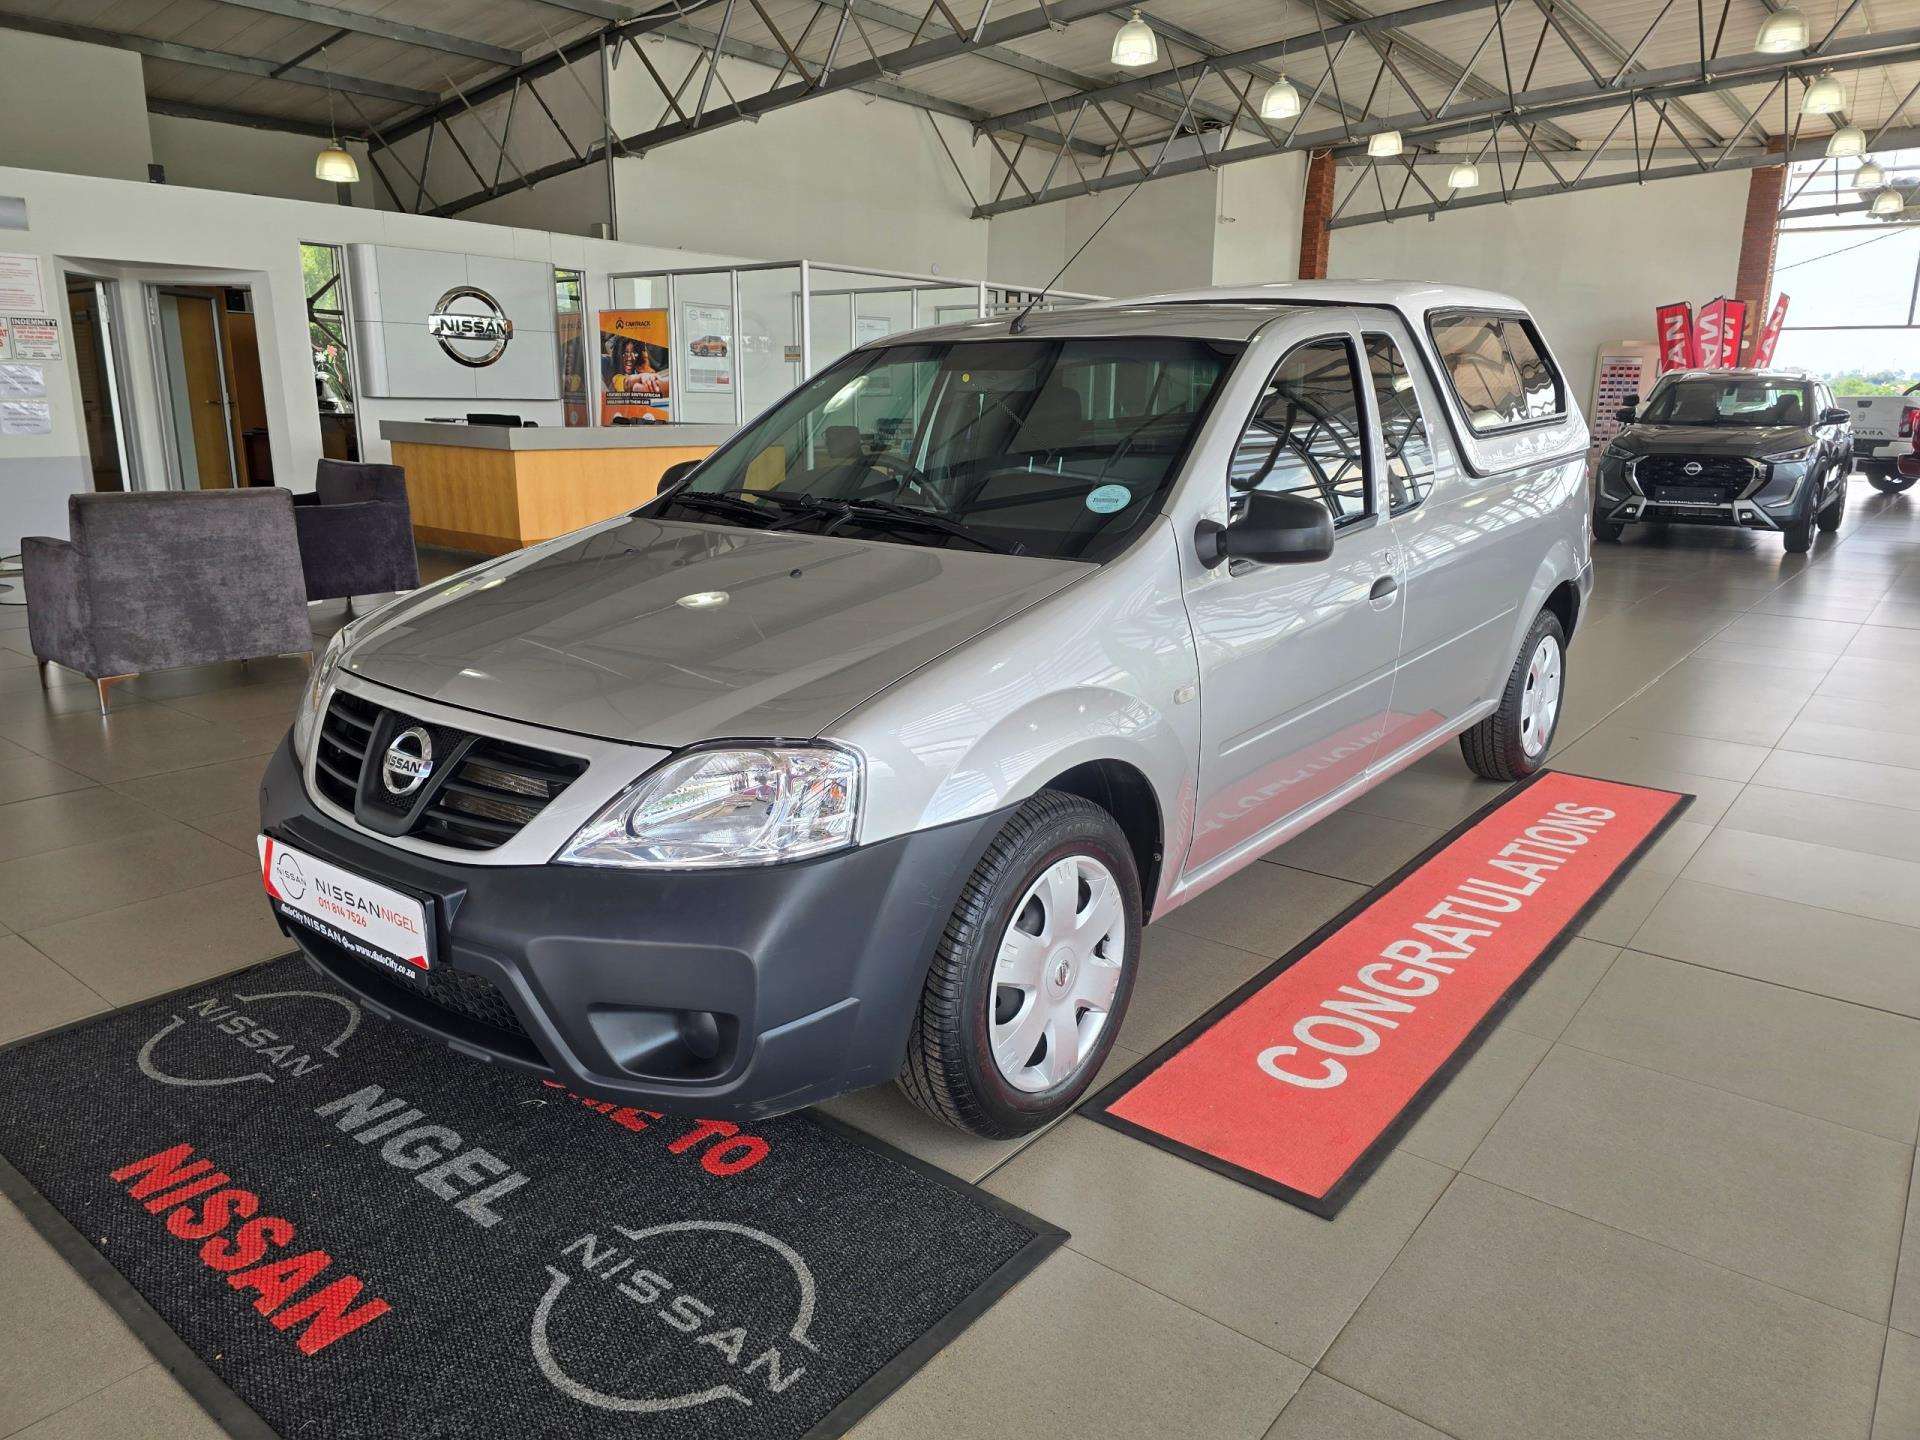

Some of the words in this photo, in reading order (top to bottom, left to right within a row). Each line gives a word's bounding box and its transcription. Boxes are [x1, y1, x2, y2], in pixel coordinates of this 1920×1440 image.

[11, 318, 57, 326] INDEMNITY
[440, 319, 506, 335] NISSAN
[386, 752, 421, 774] NISSAN
[276, 866, 307, 887] NISSAN
[303, 914, 342, 944] NISSAN
[318, 896, 331, 911] 011
[332, 903, 346, 918] 814
[346, 908, 367, 928] 7526
[1256, 802, 1616, 1090] CONGRATULATIONS
[187, 998, 324, 1077] NISSAN
[314, 1083, 531, 1228] NIGEL
[668, 1118, 771, 1177] TO
[109, 1142, 393, 1357] NISSAN
[550, 1233, 807, 1394] NISSAN
